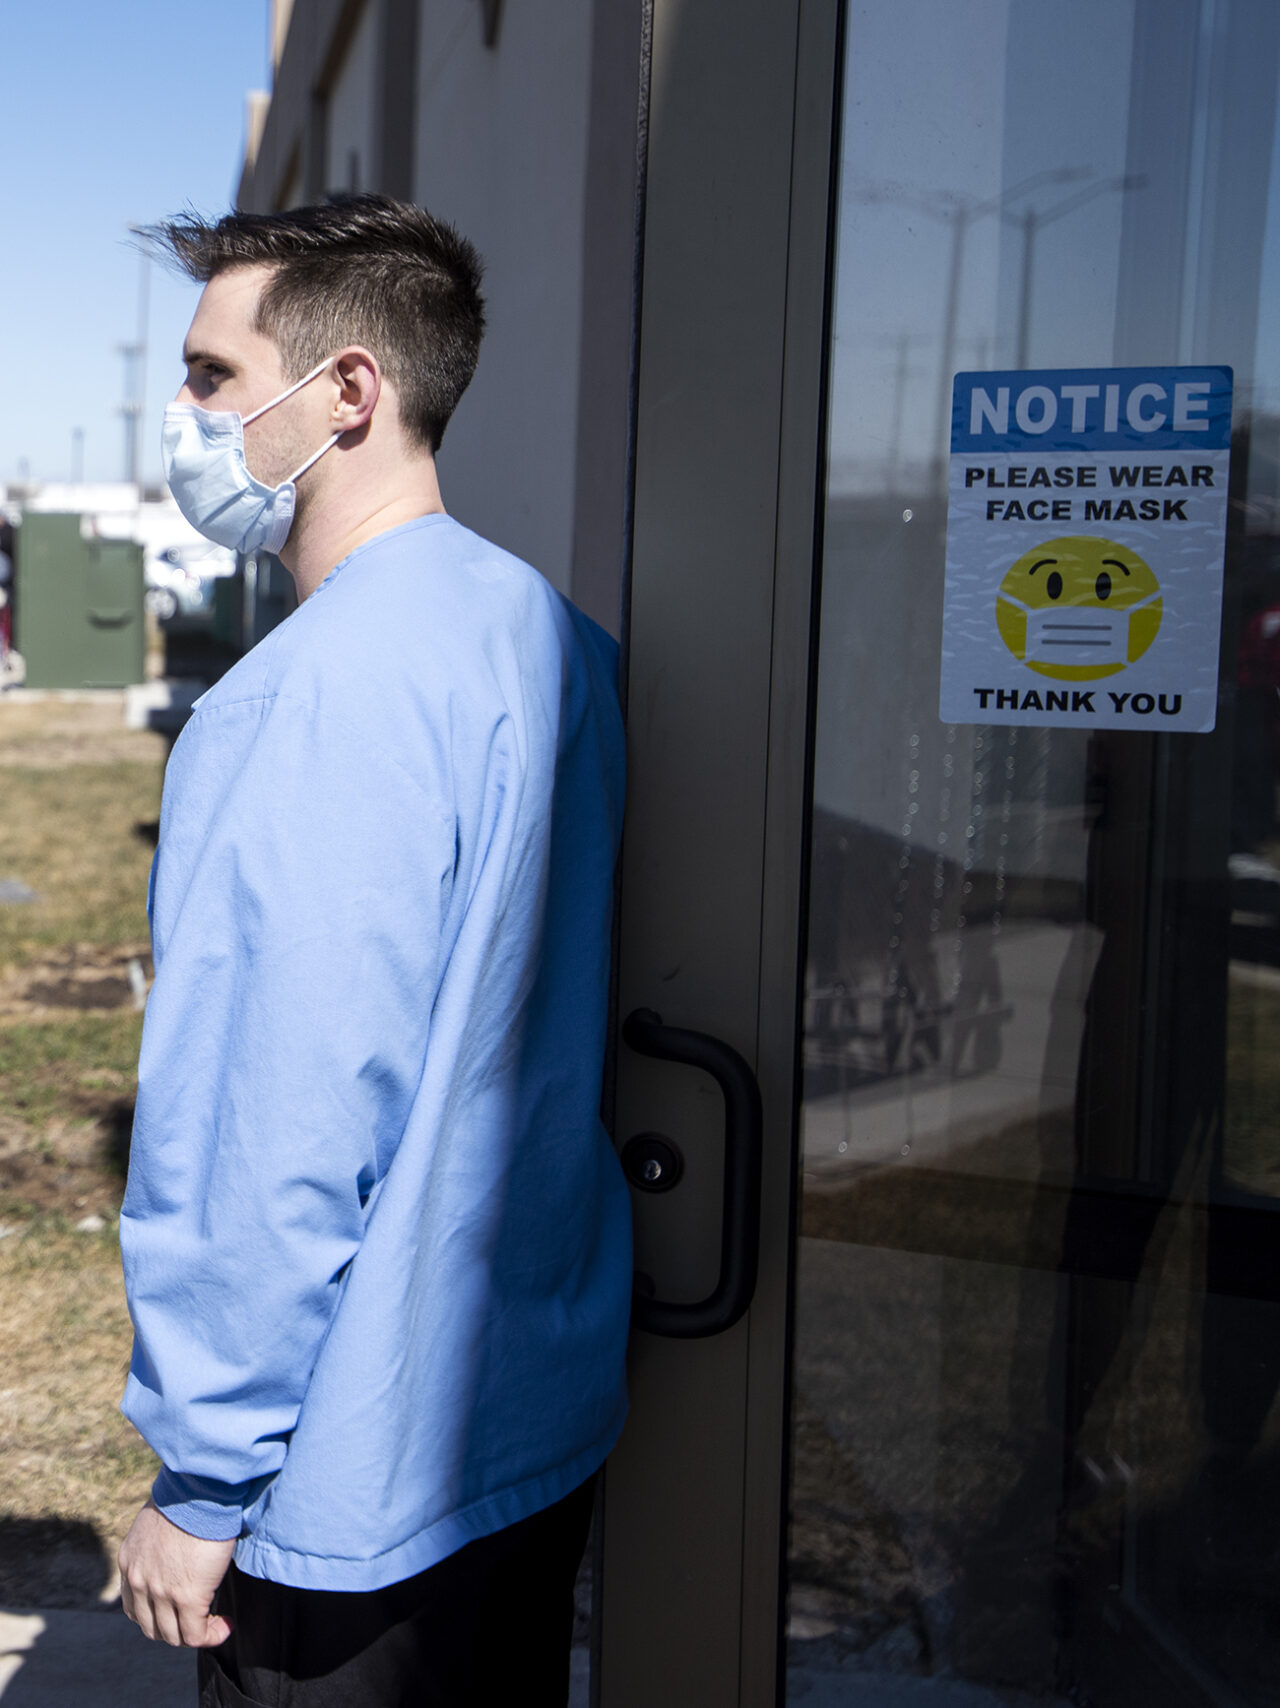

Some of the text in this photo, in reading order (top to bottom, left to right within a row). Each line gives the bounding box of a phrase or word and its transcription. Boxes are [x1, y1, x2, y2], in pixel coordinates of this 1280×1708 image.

[970, 382, 1211, 435] NOTICE
[965, 465, 1215, 488] PLEASE WEAR
[986, 499, 1188, 521] FACE MASK
[974, 688, 1182, 716] THANK YOU
